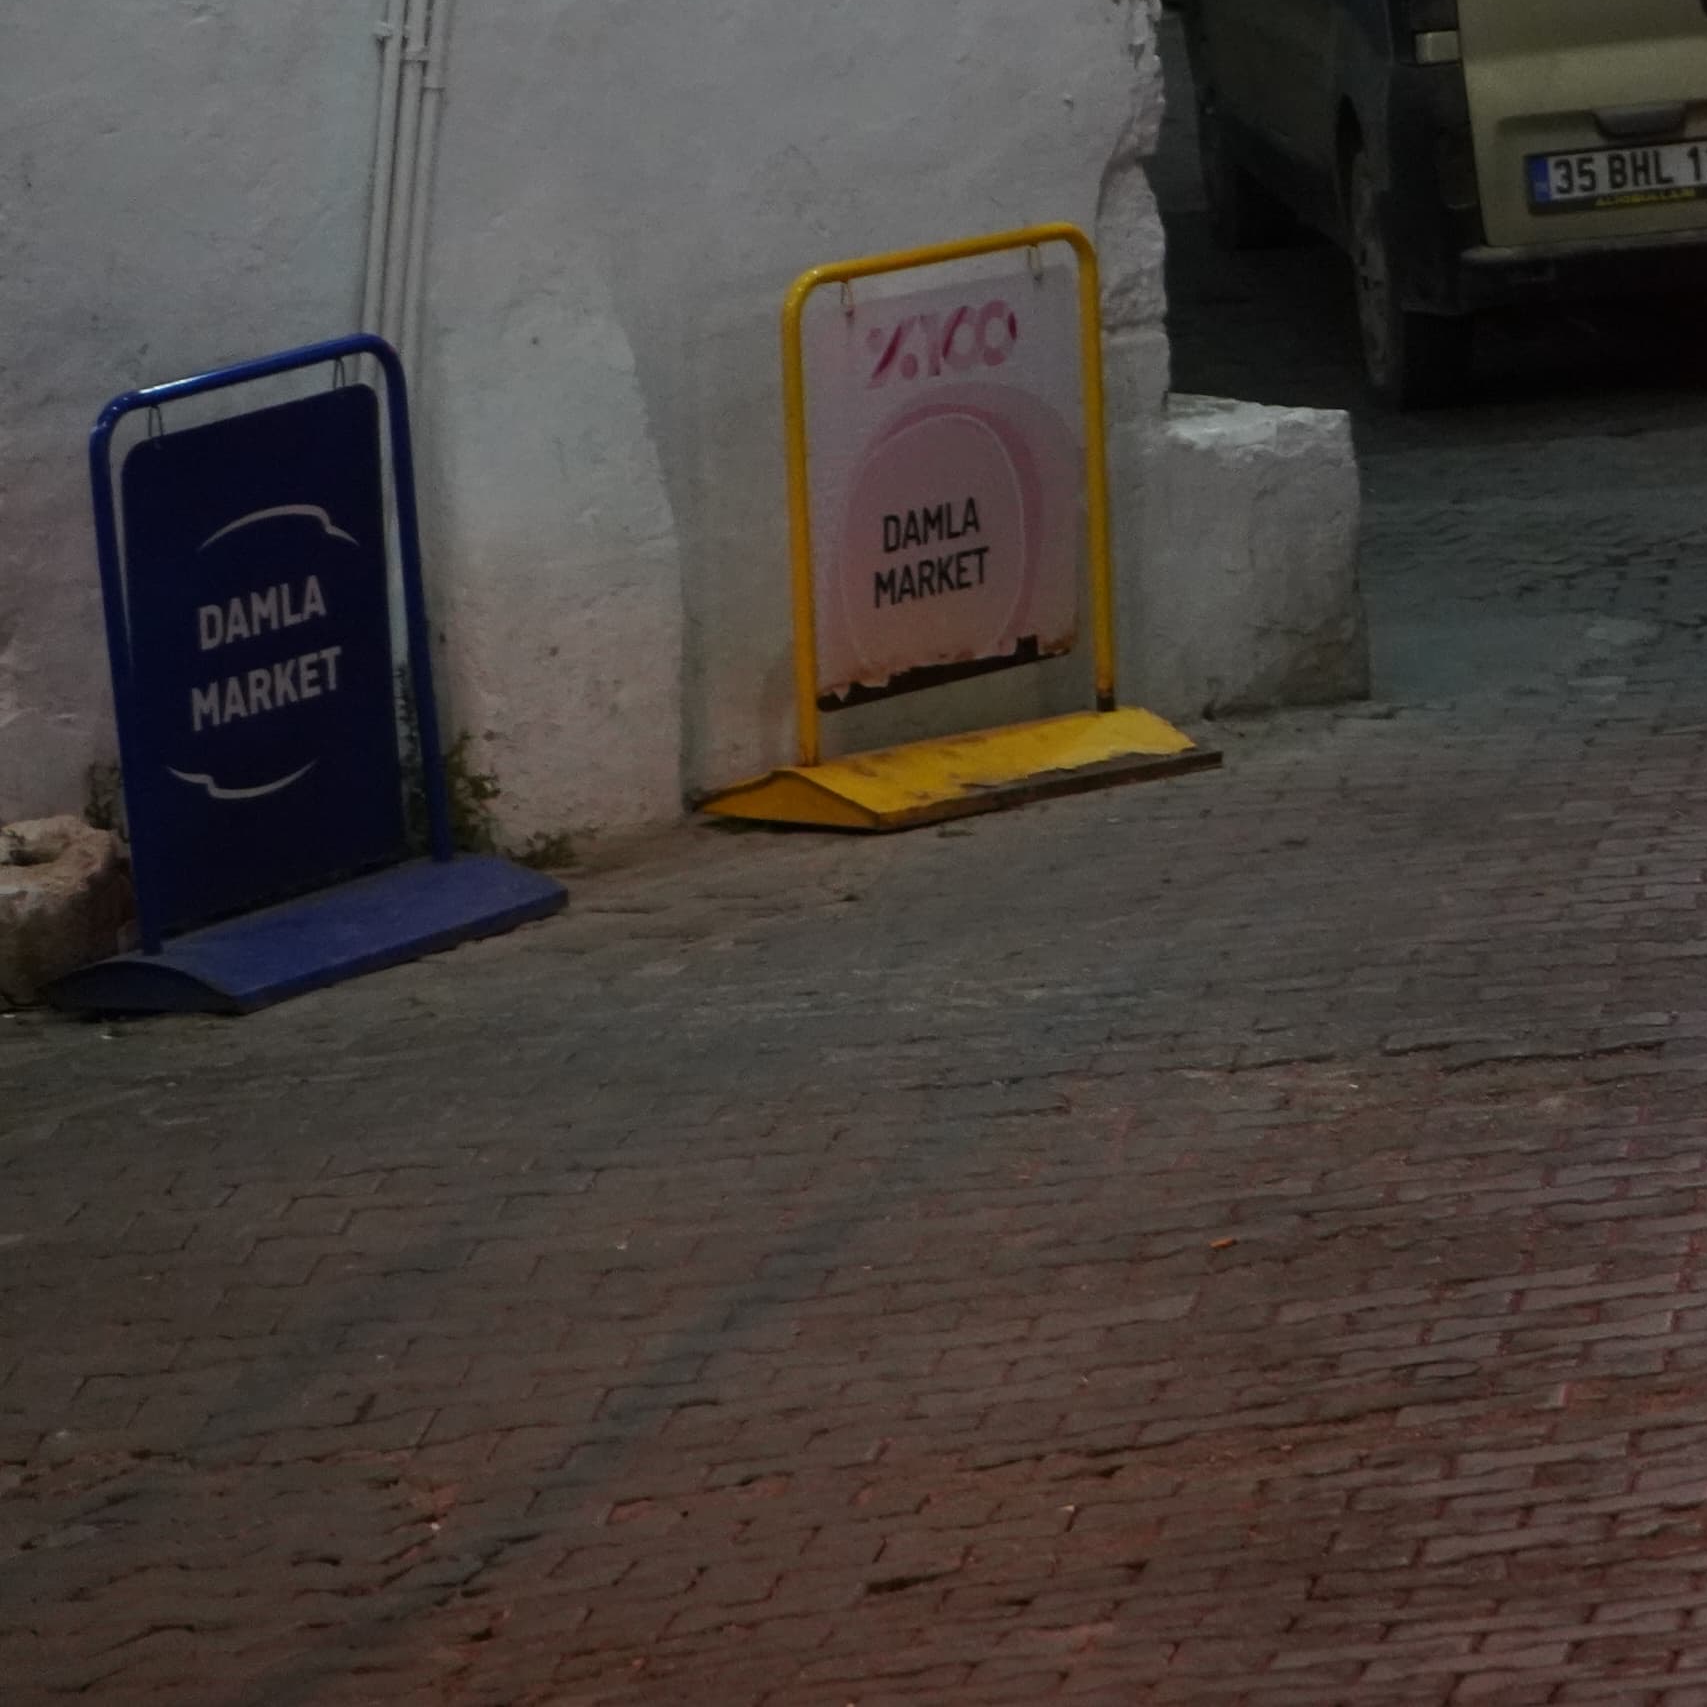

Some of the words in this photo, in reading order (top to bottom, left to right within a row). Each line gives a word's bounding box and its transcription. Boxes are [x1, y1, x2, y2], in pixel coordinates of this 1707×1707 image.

[1554, 157, 1596, 193] 35
[1607, 150, 1674, 189] BHL
[882, 497, 980, 553] DAMLA
[874, 546, 990, 608] MARKET
[198, 574, 327, 650] DAMLA
[191, 645, 342, 732] MARKET
